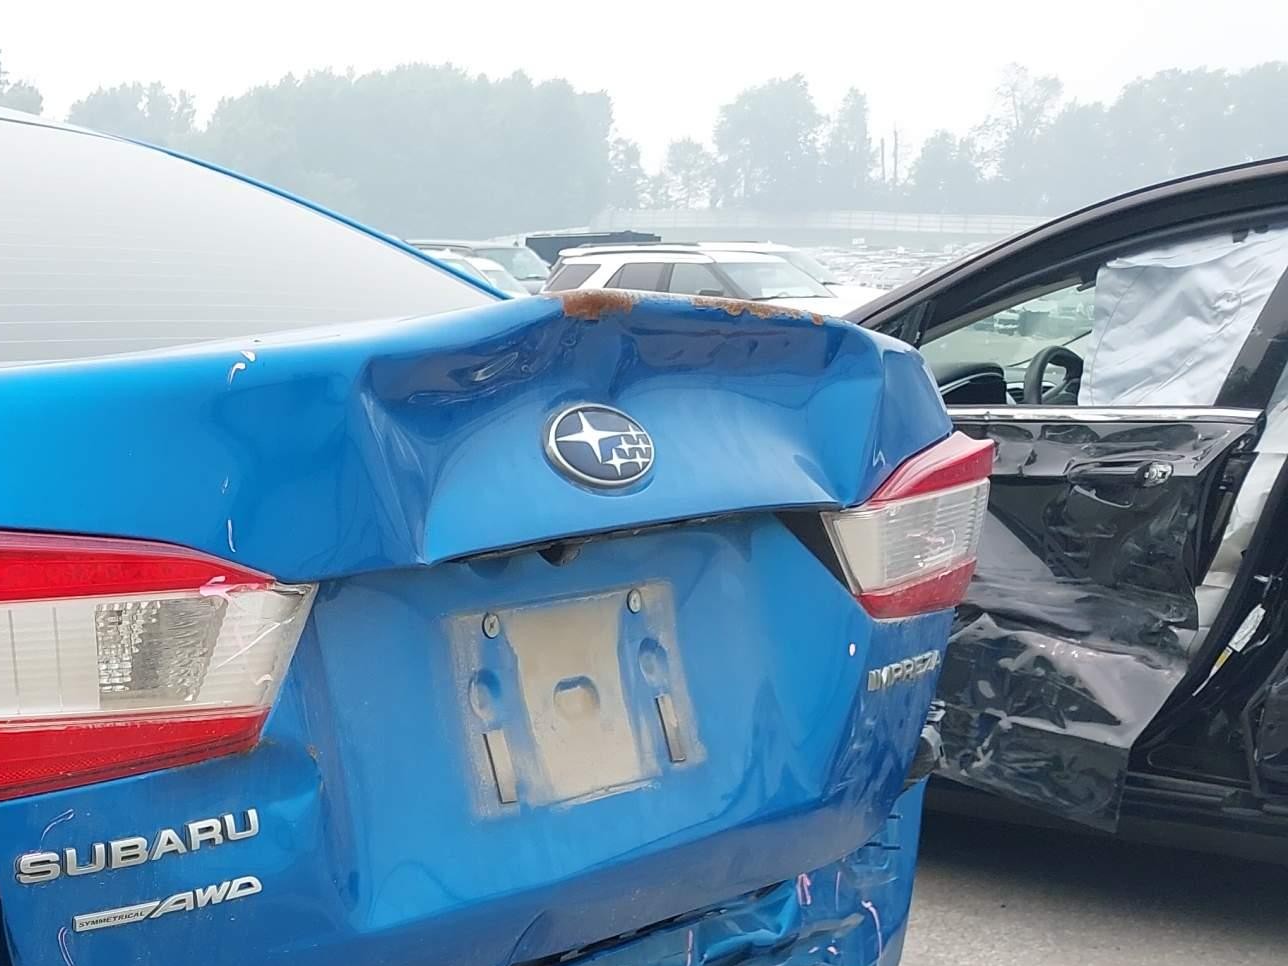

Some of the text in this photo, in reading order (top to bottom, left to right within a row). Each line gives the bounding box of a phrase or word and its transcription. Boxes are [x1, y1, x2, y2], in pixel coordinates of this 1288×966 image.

[15, 808, 260, 884] SUBARU
[78, 876, 262, 928] SYMMETRICAL AWD
